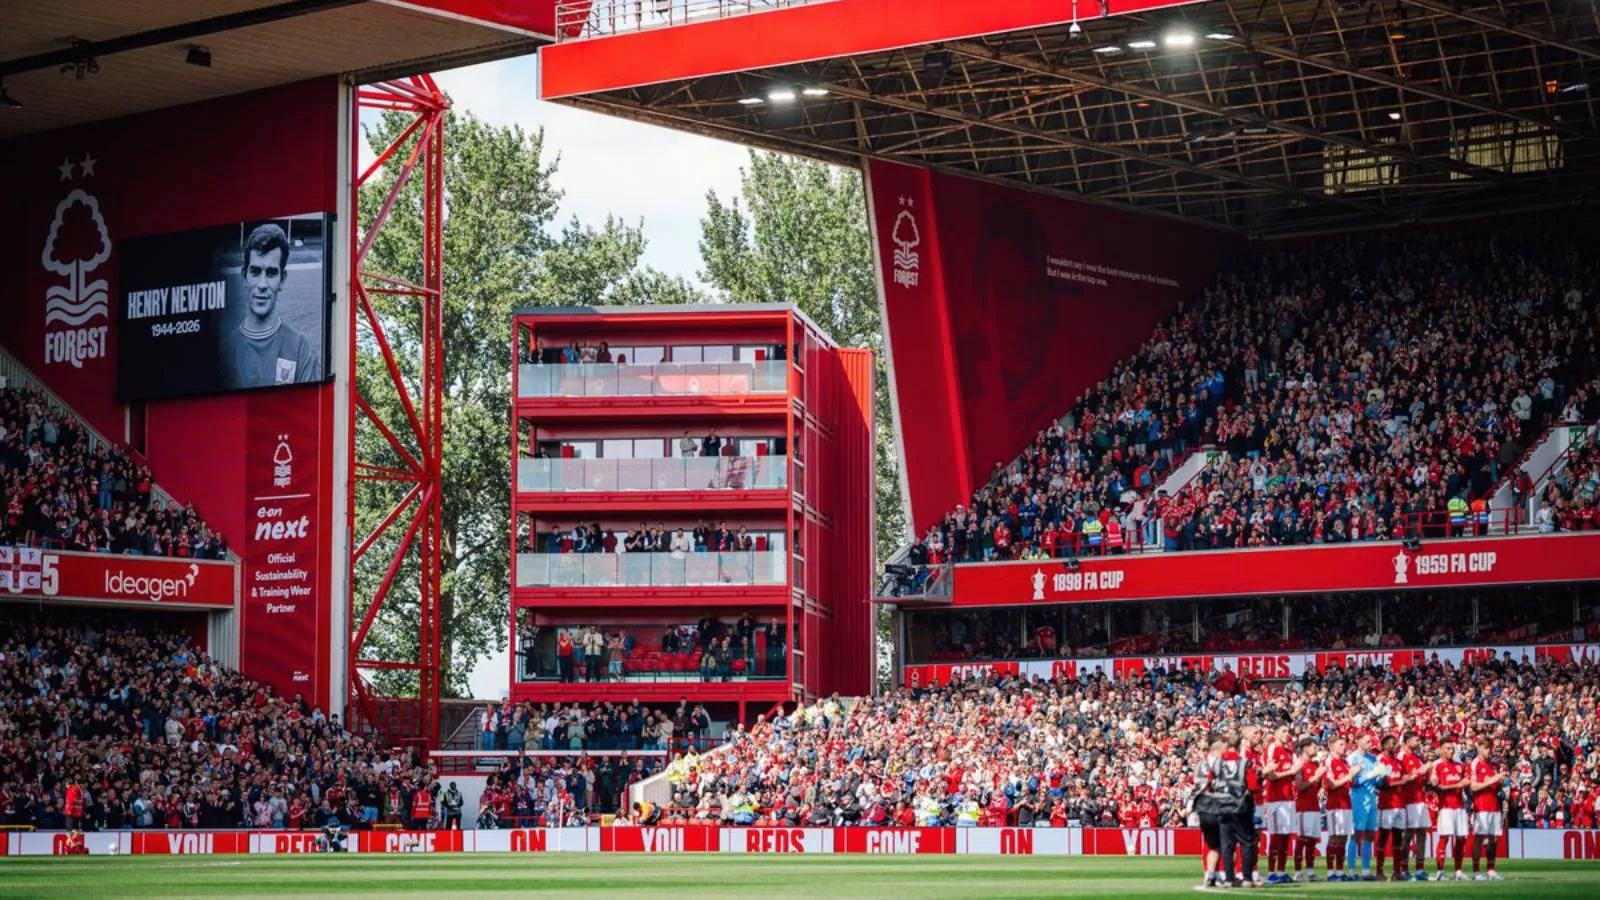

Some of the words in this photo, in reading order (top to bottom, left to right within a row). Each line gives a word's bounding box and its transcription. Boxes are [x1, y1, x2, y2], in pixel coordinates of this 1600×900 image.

[128, 288, 168, 320] HENRY
[171, 281, 226, 315] NEWTON
[151, 320, 200, 337] 1944-2026
[255, 515, 310, 541] next
[267, 553, 295, 564] Official
[1415, 554, 1448, 575] 1959
[1451, 553, 1467, 573] FA
[1469, 552, 1496, 573] CUP
[255, 568, 308, 581] Sustainability
[1052, 573, 1082, 592] 1898
[1084, 572, 1099, 590] FA
[1100, 571, 1125, 590] CUP
[105, 571, 187, 601] Ideagen
[251, 587, 257, 597] &
[259, 586, 289, 599] Training
[290, 585, 312, 597] Wear
[266, 603, 296, 613] Partner
[1238, 656, 1290, 678] REDS
[275, 834, 328, 854] RED
[511, 829, 546, 851] ON
[641, 828, 685, 851] YOU
[746, 829, 805, 853] REDS
[866, 831, 920, 853] COME
[1000, 829, 1033, 855] ON
[1563, 830, 1600, 859] ON
